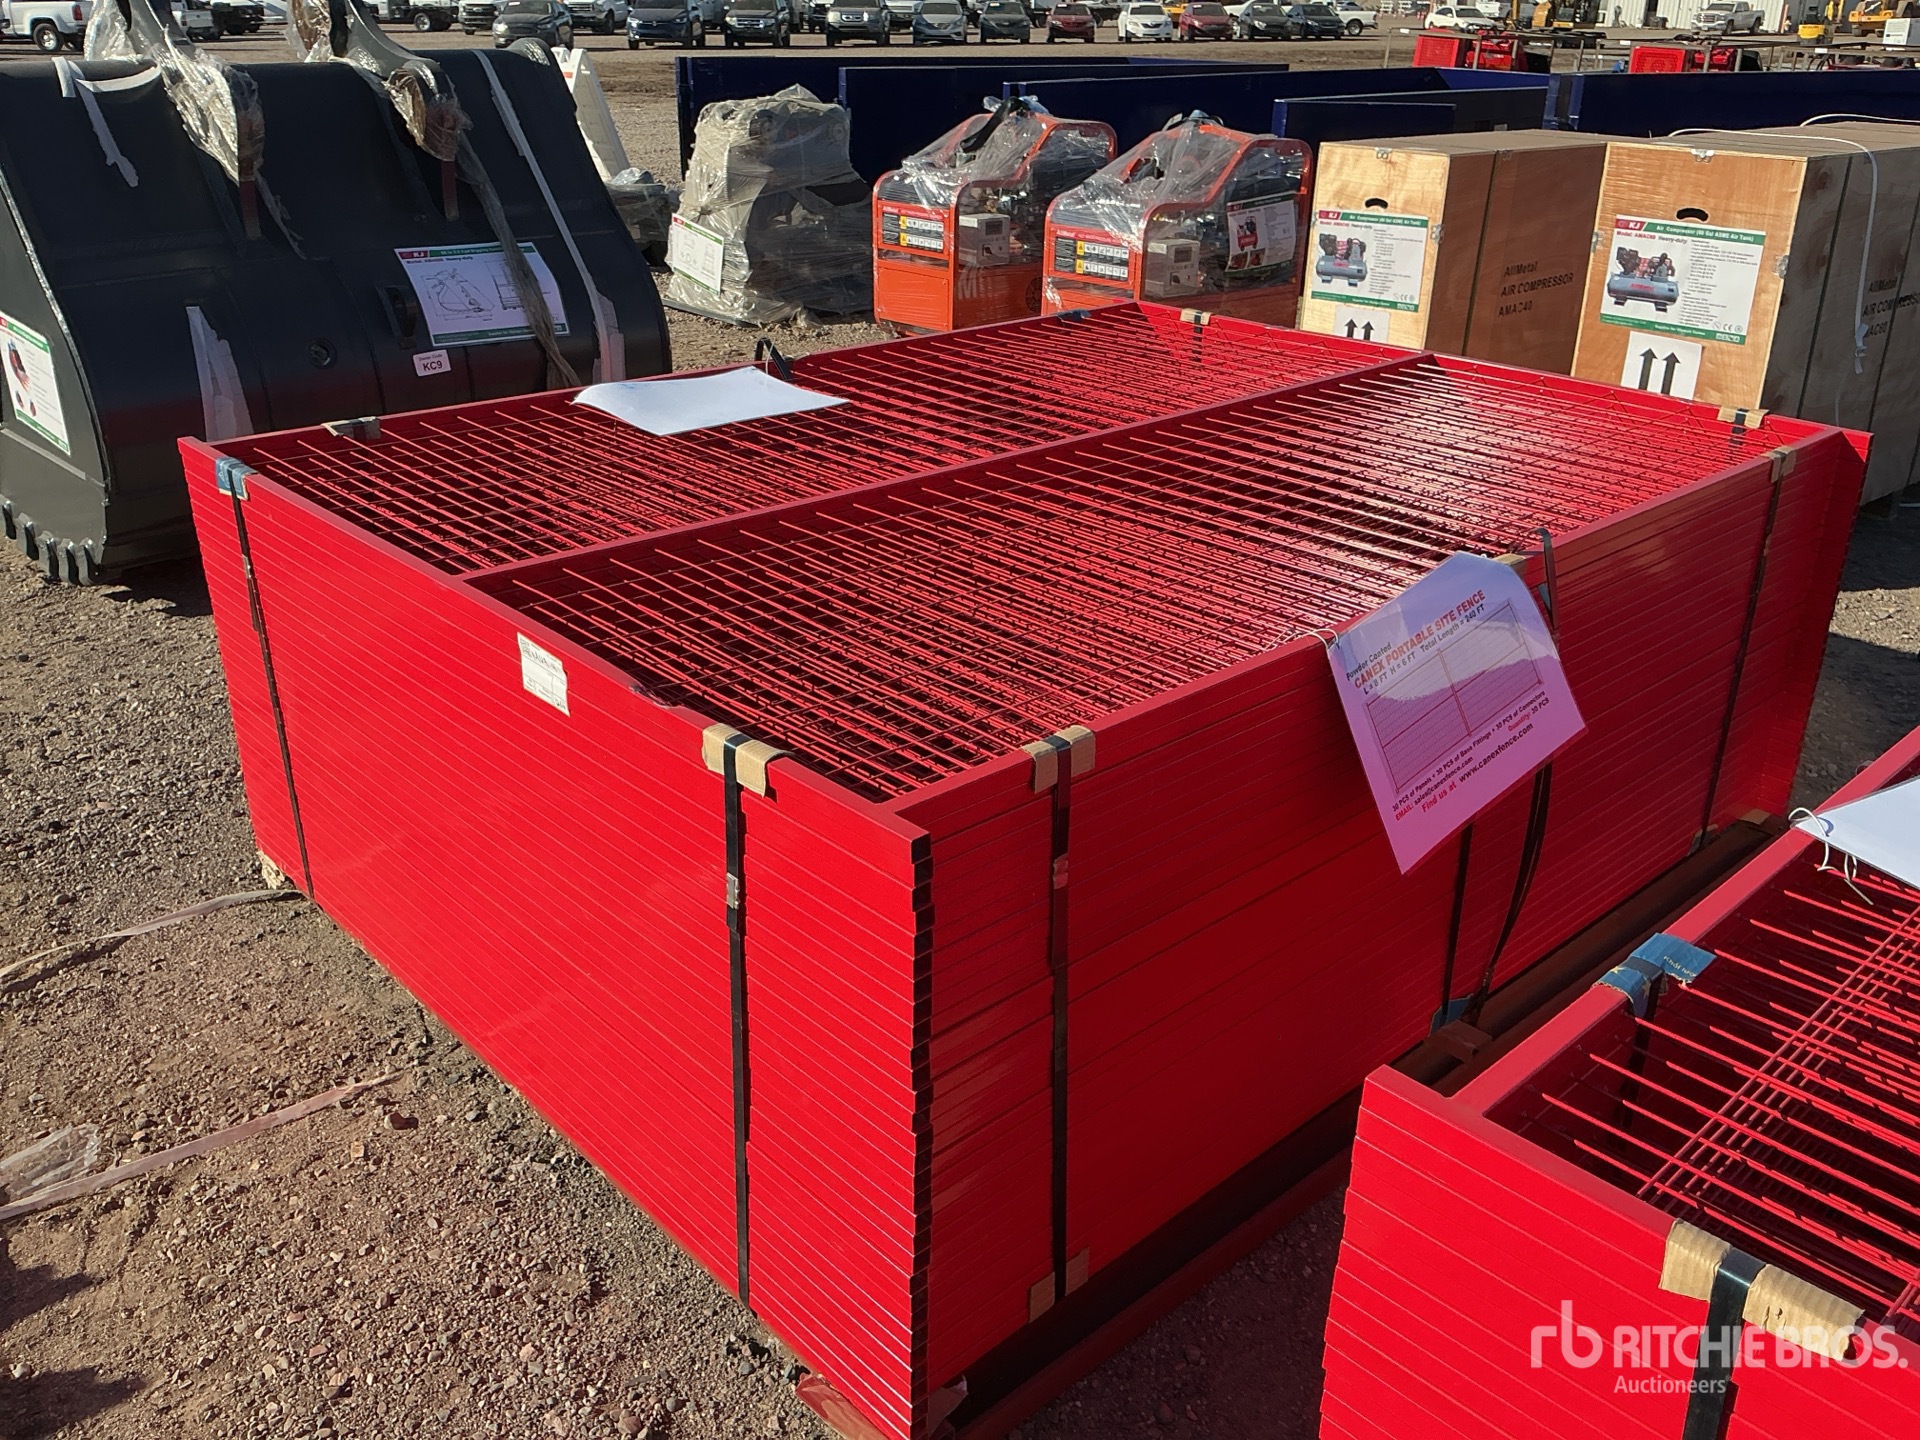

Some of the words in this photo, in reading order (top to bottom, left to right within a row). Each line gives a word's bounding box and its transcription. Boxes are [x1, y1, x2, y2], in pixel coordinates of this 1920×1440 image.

[1628, 221, 1641, 229] KJ
[1503, 261, 1538, 277] AllMetal
[1501, 284, 1516, 297] AIR
[1518, 272, 1574, 294] COMPRESSOR
[1498, 300, 1533, 317] AMAC40
[423, 360, 443, 371] KC9
[1354, 660, 1386, 689] CANEX
[1385, 625, 1434, 665] PORTABLE
[1434, 610, 1457, 631] SITE
[1456, 589, 1486, 617] FENCE
[1363, 687, 1369, 695] L
[1373, 679, 1379, 687] 8
[1378, 672, 1389, 684] FT
[1389, 666, 1397, 675] H
[1401, 658, 1408, 667] 6
[1407, 651, 1416, 664] FT
[1420, 638, 1438, 653] Total
[1437, 623, 1460, 642] Length
[1464, 610, 1477, 623] 240
[1475, 603, 1485, 615] FT
[1346, 660, 1368, 681] Powder
[1369, 642, 1392, 663] Coated
[1530, 705, 1538, 715] 30
[1538, 697, 1550, 709] PCS
[1392, 802, 1399, 812] 30
[1399, 795, 1410, 807] PCS
[1415, 776, 1432, 792] Panels
[1436, 767, 1443, 776] 30
[1443, 758, 1454, 771] PCS
[1459, 745, 1473, 757] Base
[1472, 731, 1492, 748] Fittings
[1495, 721, 1503, 731] 30
[1502, 714, 1513, 726] PCS
[1513, 709, 1519, 717] of
[1421, 795, 1438, 813] Find
[1438, 790, 1448, 800] us
[1449, 780, 1457, 792] at
[1458, 723, 1534, 783] www.canexfence.com
[1395, 803, 1414, 821] EMAIL:
